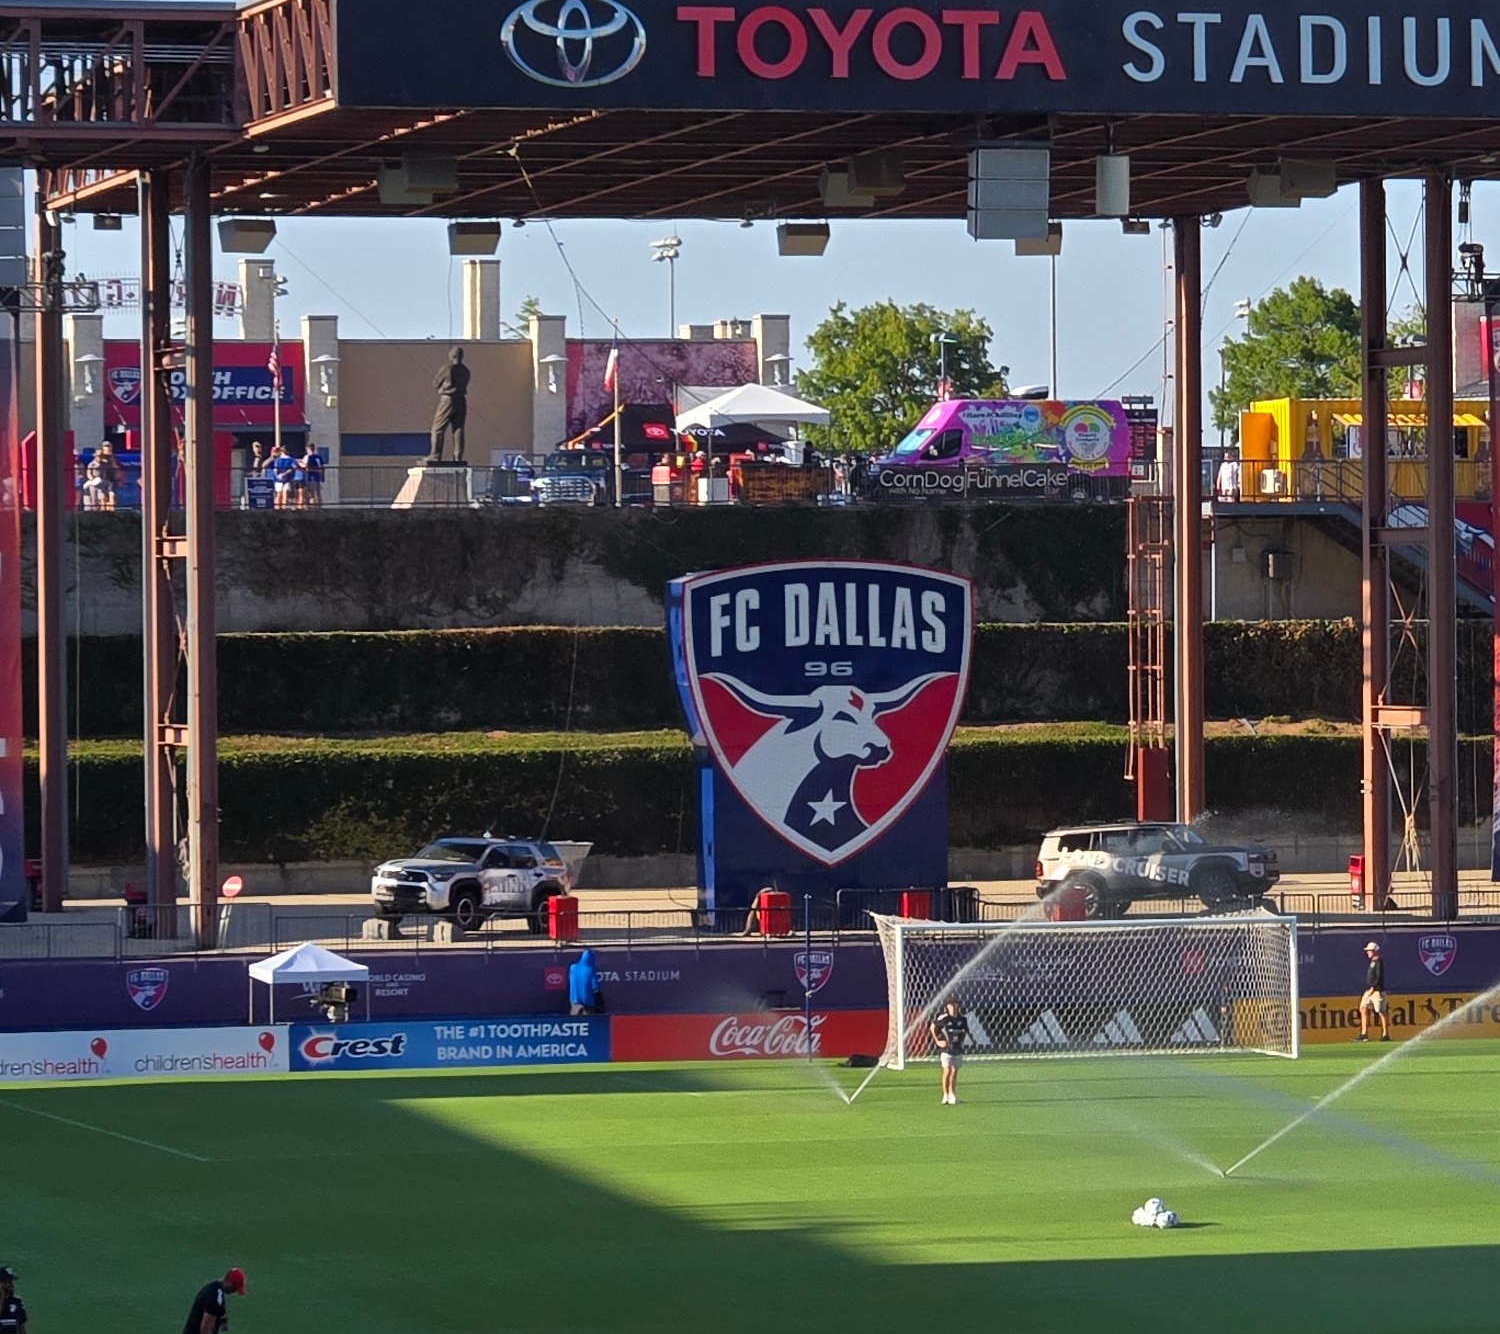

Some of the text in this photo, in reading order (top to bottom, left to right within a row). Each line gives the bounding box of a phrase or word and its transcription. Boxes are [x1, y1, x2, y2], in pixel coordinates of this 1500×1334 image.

[676, 5, 1067, 82] TOYOTA
[879, 470, 965, 492] CornDog
[709, 581, 947, 658] FC DALLAS
[803, 660, 854, 677] 96
[1113, 856, 1190, 888] CRUISER
[368, 973, 426, 982] ORLD CASINO
[625, 970, 680, 982] STADIUM
[375, 988, 409, 997] RESORT
[434, 1022, 590, 1040] THE #1 TOOTHPASTE
[302, 1033, 407, 1060] Crest
[437, 1042, 588, 1060] BRAND IN AMERICA
